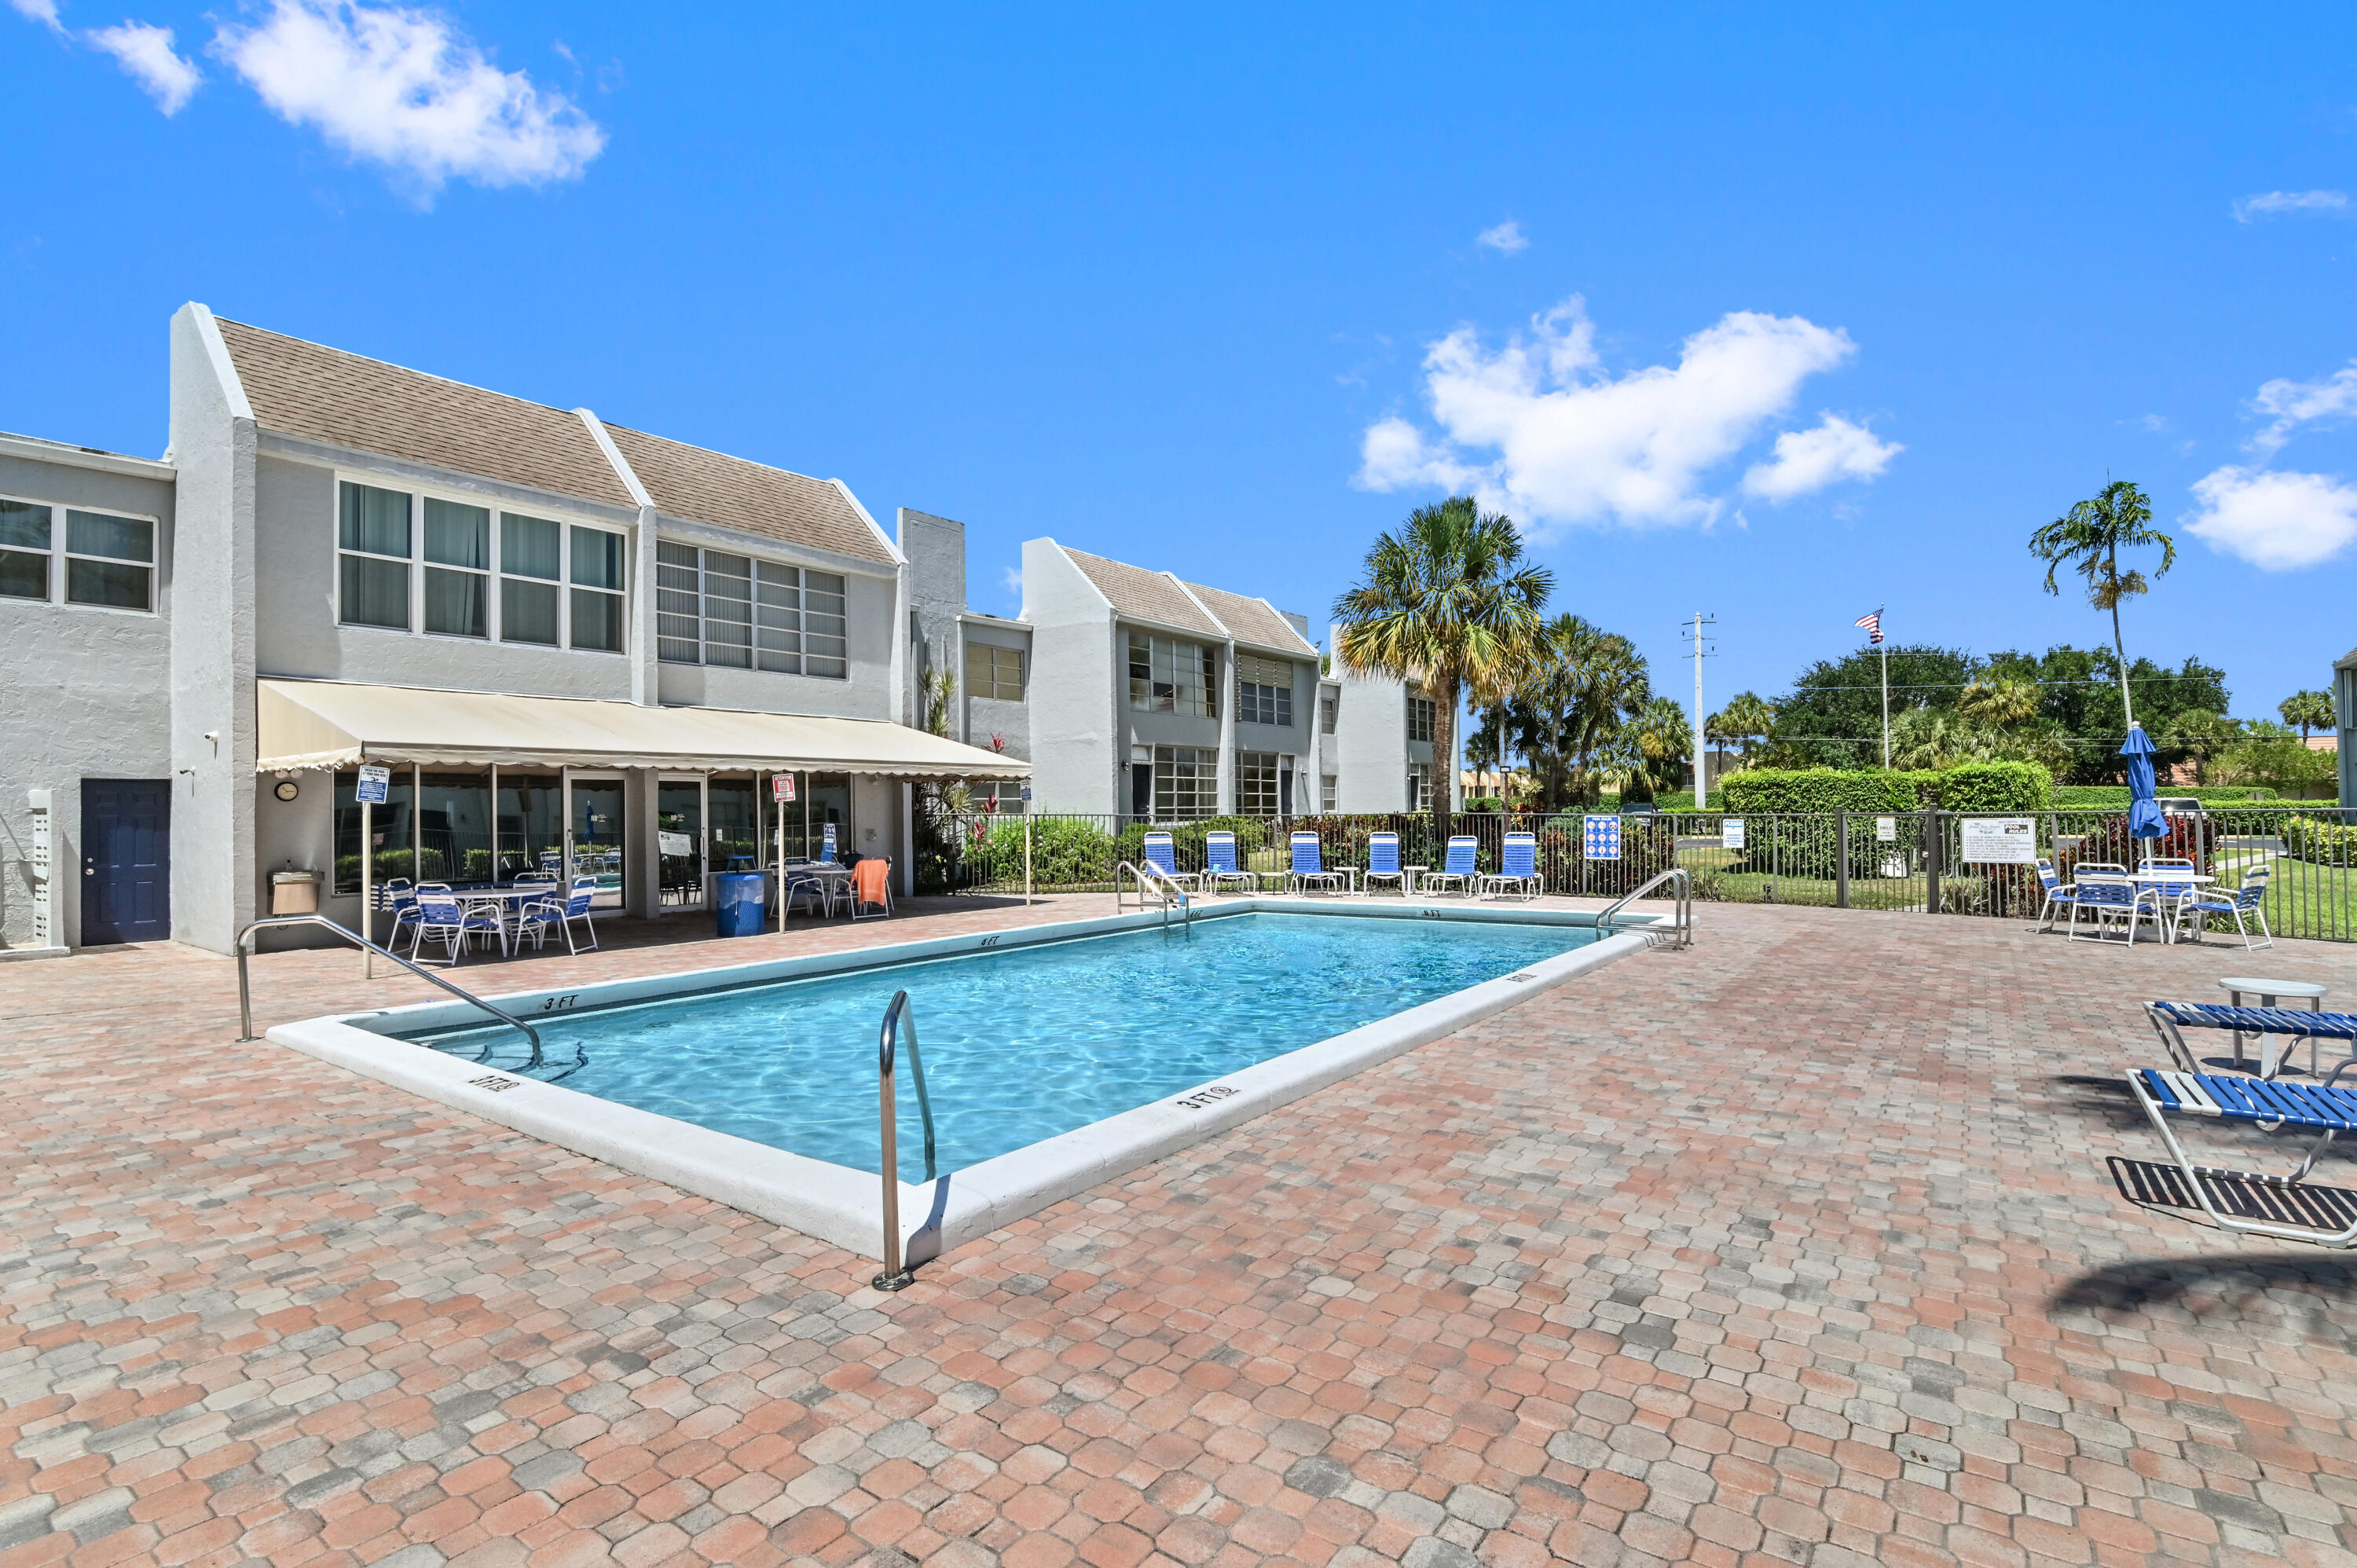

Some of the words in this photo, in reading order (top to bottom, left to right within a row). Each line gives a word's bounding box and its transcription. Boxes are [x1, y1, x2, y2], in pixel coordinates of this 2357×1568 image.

[988, 936, 1000, 946] FT
[544, 998, 555, 1010] 3
[559, 995, 579, 1009] FT
[475, 1078, 511, 1088] FT
[1189, 1091, 1222, 1104] FT
